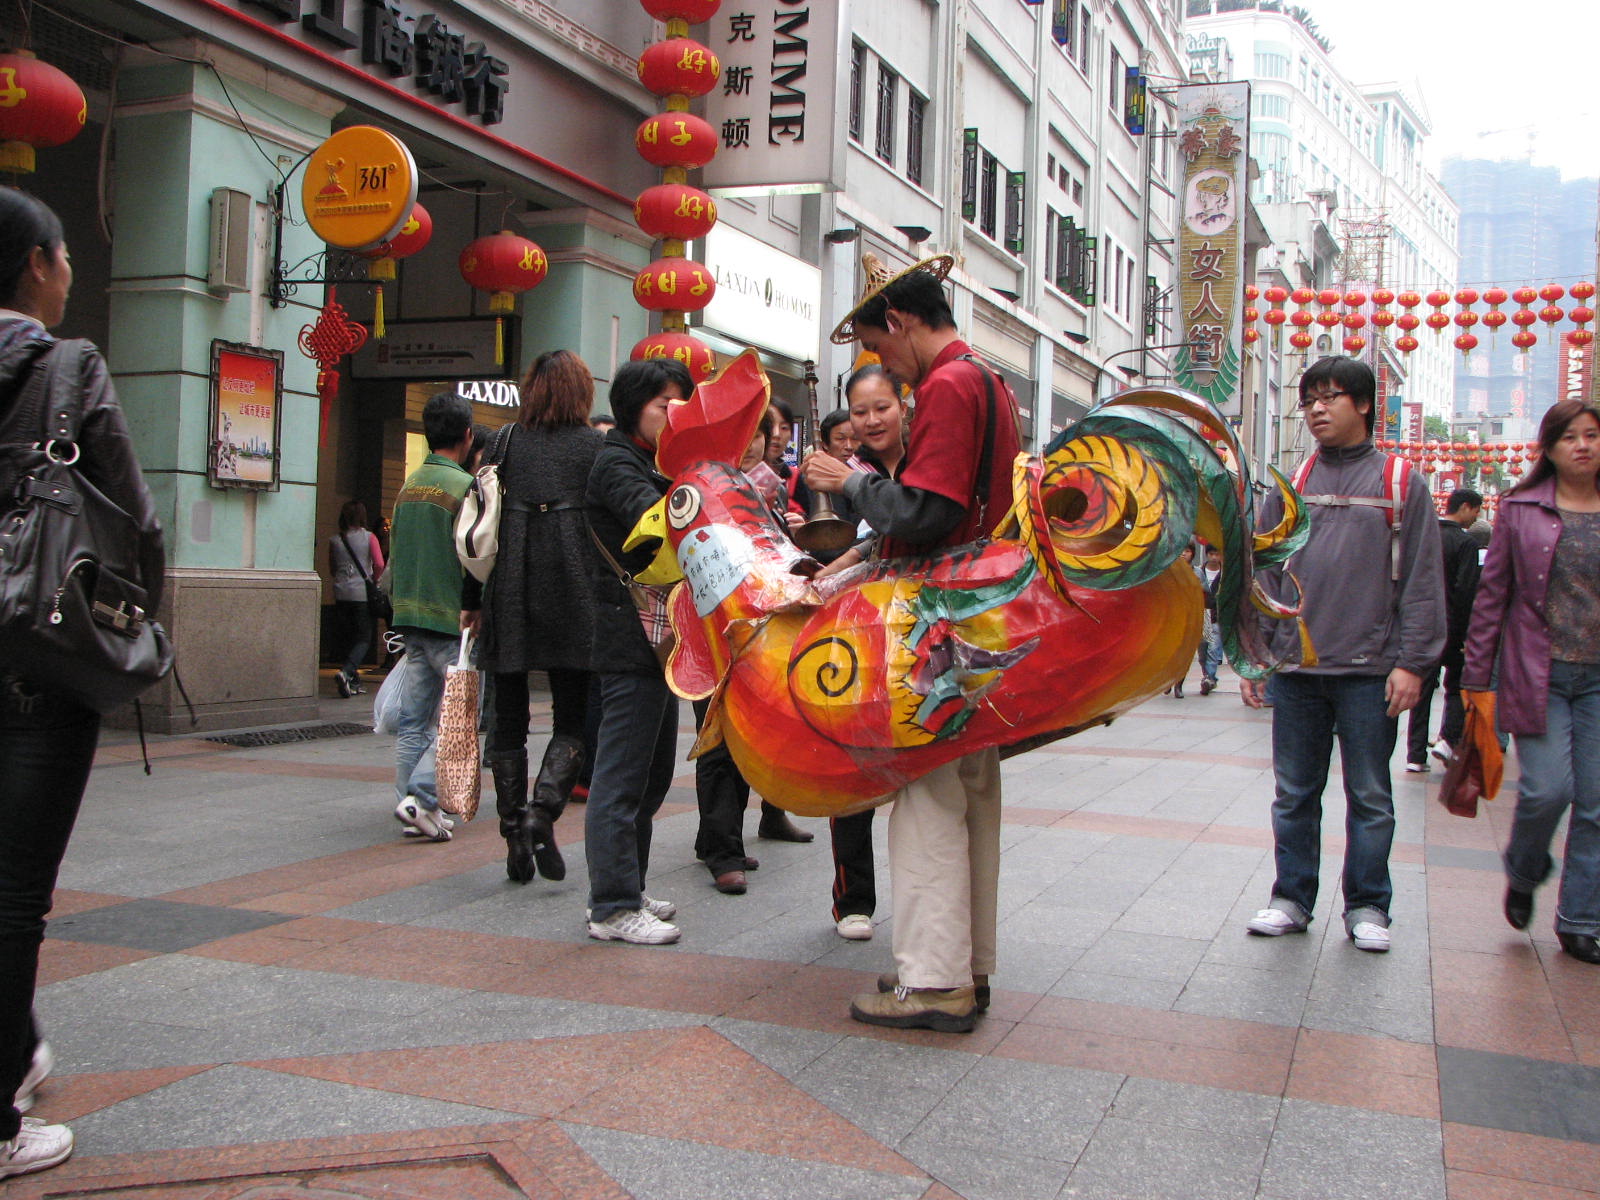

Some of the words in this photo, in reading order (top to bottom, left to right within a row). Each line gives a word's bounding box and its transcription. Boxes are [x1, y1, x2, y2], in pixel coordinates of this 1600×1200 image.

[722, 12, 756, 148] 克斯顿
[768, 0, 809, 146] MME
[1188, 240, 1226, 363] 女人街
